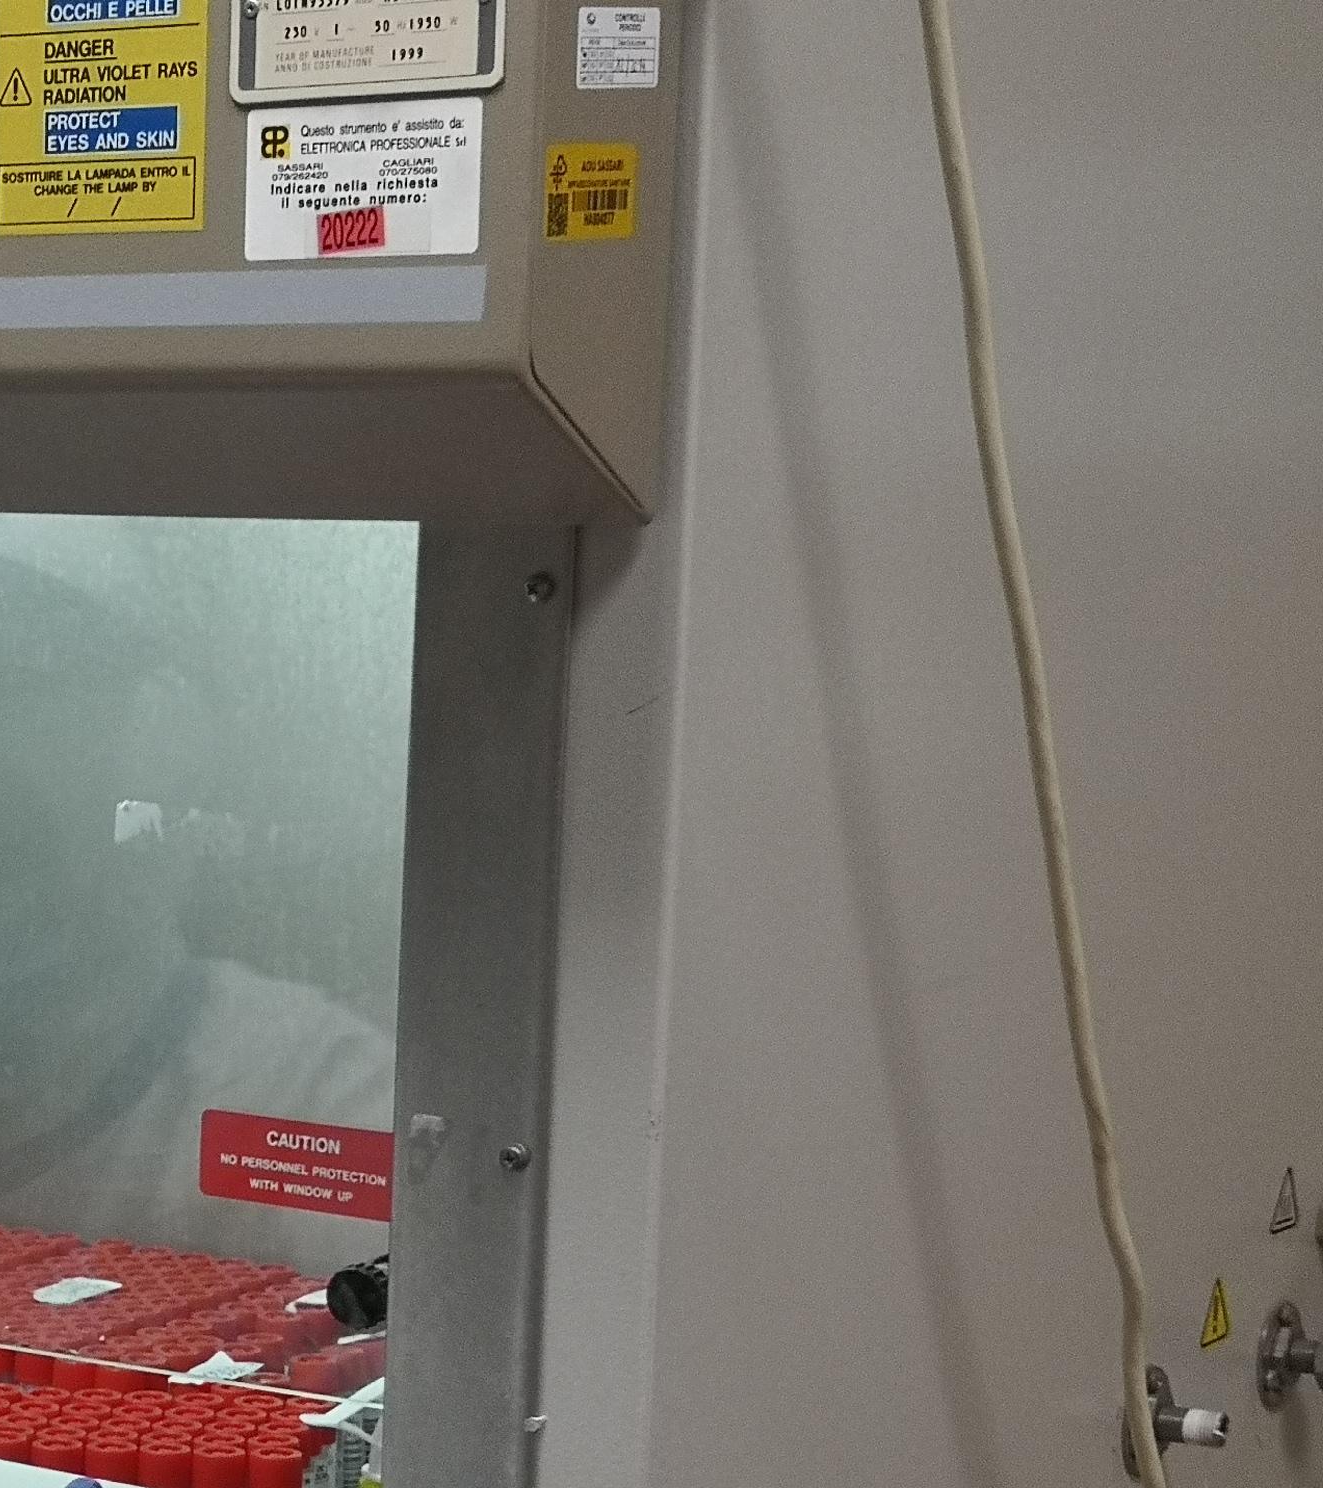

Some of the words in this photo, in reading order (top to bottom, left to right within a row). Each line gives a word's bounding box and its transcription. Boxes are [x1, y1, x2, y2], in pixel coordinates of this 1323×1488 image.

[50, 1, 101, 21] OCCHI
[108, 3, 118, 18] E
[125, 0, 175, 16] PELLE
[45, 39, 115, 59] DANGER
[275, 52, 296, 62] YEAR
[313, 45, 375, 60] MANUFACTURE
[391, 47, 424, 61] 1999
[44, 67, 90, 85] ULTRA
[97, 64, 151, 81] VIOLET
[158, 61, 198, 78] RAYS
[275, 63, 297, 73] ANNO
[314, 58, 372, 72] COSTRUZIONE
[44, 85, 126, 105] RADIATION
[47, 111, 121, 130] PROTECT
[300, 124, 335, 138] Questo
[339, 122, 387, 135] strumento
[405, 117, 444, 131] assistito
[449, 116, 465, 129] da:
[47, 135, 89, 151] EYES
[94, 133, 129, 150] AND
[136, 130, 175, 148] SKIN
[301, 140, 366, 155] ELETTRONICA
[370, 136, 451, 151] PROFESSIONALE
[455, 136, 466, 148] Srl
[2, 170, 63, 183] SOSTITUIRE
[67, 169, 81, 181] LA
[85, 167, 136, 181] LAMPADA
[141, 166, 177, 179] ENTRO
[182, 164, 191, 177] IL
[272, 171, 328, 181] 079/262420
[379, 166, 438, 177] 070/275080
[277, 163, 324, 172] SASSARI
[382, 158, 434, 168] CAGLIARI
[34, 183, 79, 196] CHANGE
[84, 182, 104, 194] THE
[108, 181, 138, 193] LAMP
[142, 181, 157, 192] BY
[270, 182, 326, 196] Indicare
[334, 179, 368, 192] nella
[376, 177, 439, 191] richiesta
[281, 196, 290, 209] il
[298, 194, 361, 211] seguente
[369, 193, 427, 206] numero:
[320, 207, 379, 250] 20222
[266, 1130, 341, 1155] CAUTION
[220, 1152, 237, 1165] NO
[241, 1155, 308, 1176] PERSONNEL
[312, 1166, 387, 1187] PROTECTION
[249, 1178, 279, 1192] WITH
[283, 1182, 333, 1201] WINDOW
[337, 1190, 353, 1202] UP
